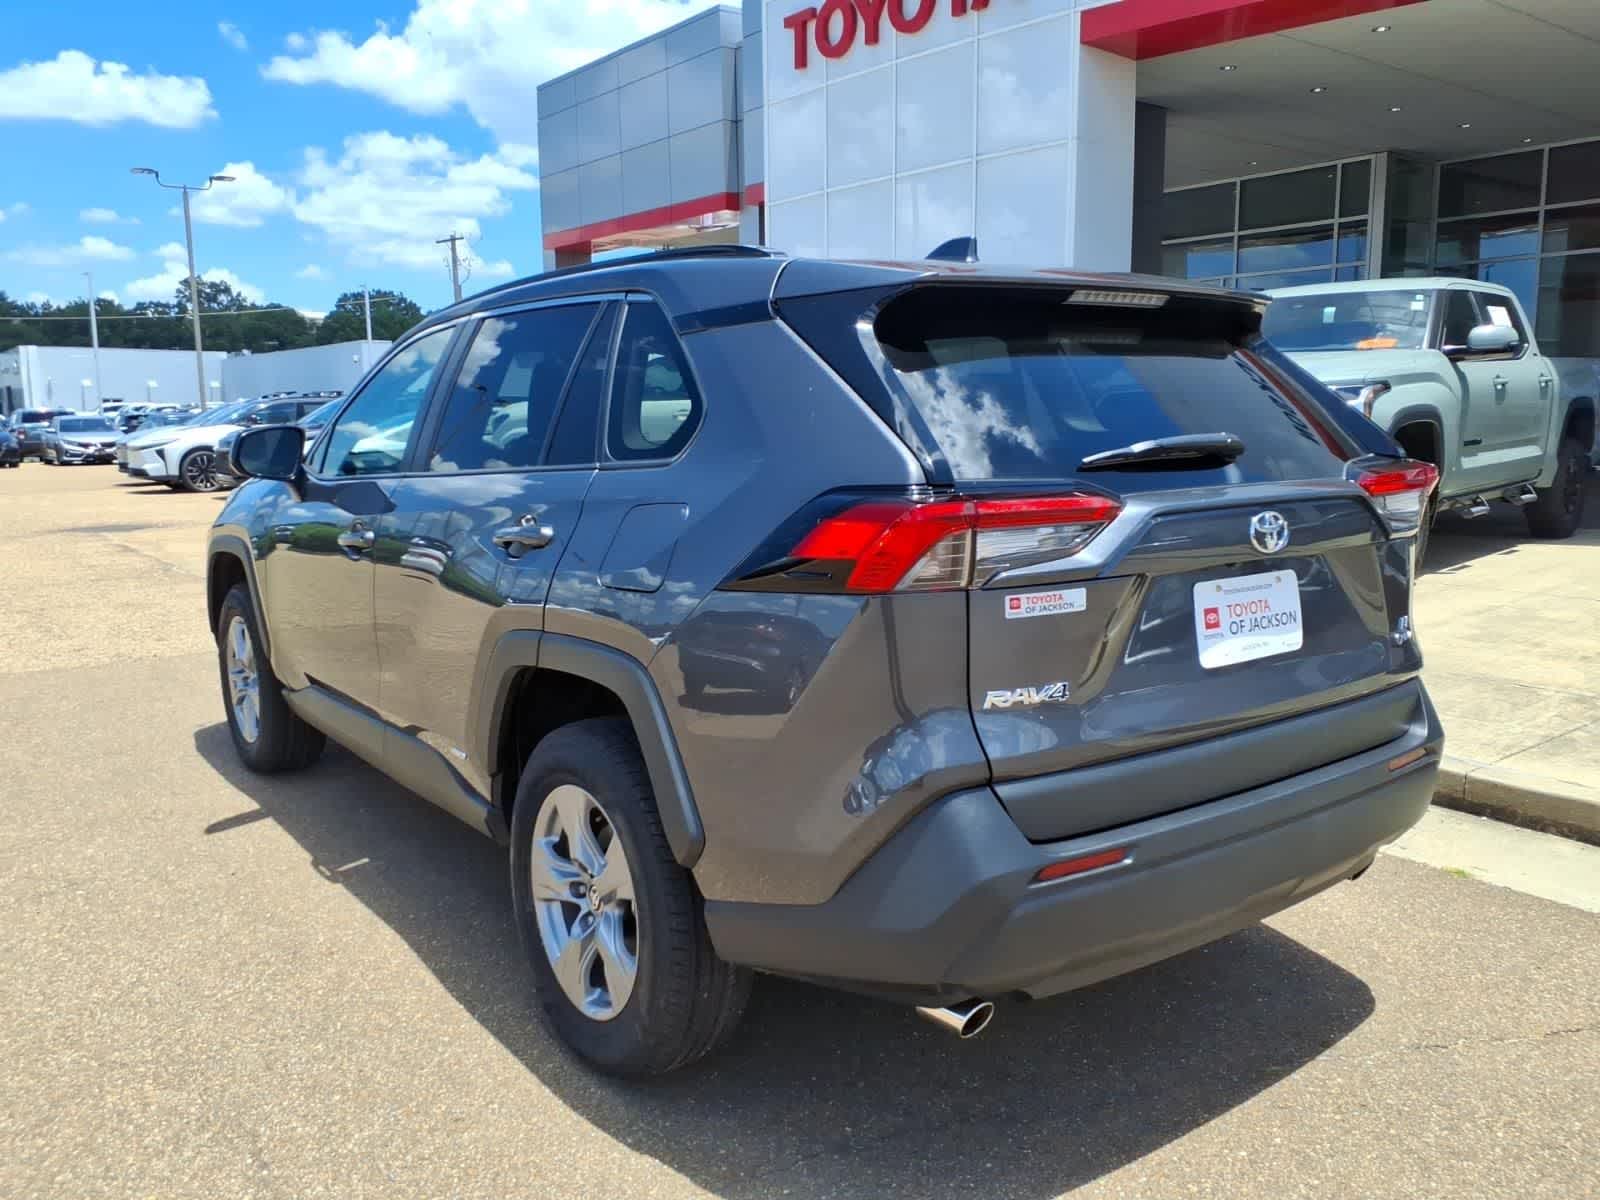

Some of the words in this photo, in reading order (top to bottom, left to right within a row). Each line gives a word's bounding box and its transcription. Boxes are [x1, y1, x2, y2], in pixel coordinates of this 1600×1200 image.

[783, 0, 991, 70] TOYO
[1025, 593, 1064, 605] TOYOTA
[1025, 606, 1037, 614] OF
[1039, 601, 1075, 613] JACKSON
[1226, 599, 1271, 618] TOYOTA
[1229, 620, 1246, 635] OF
[1248, 610, 1297, 632] JACKSON
[983, 681, 1070, 709] RAV4
